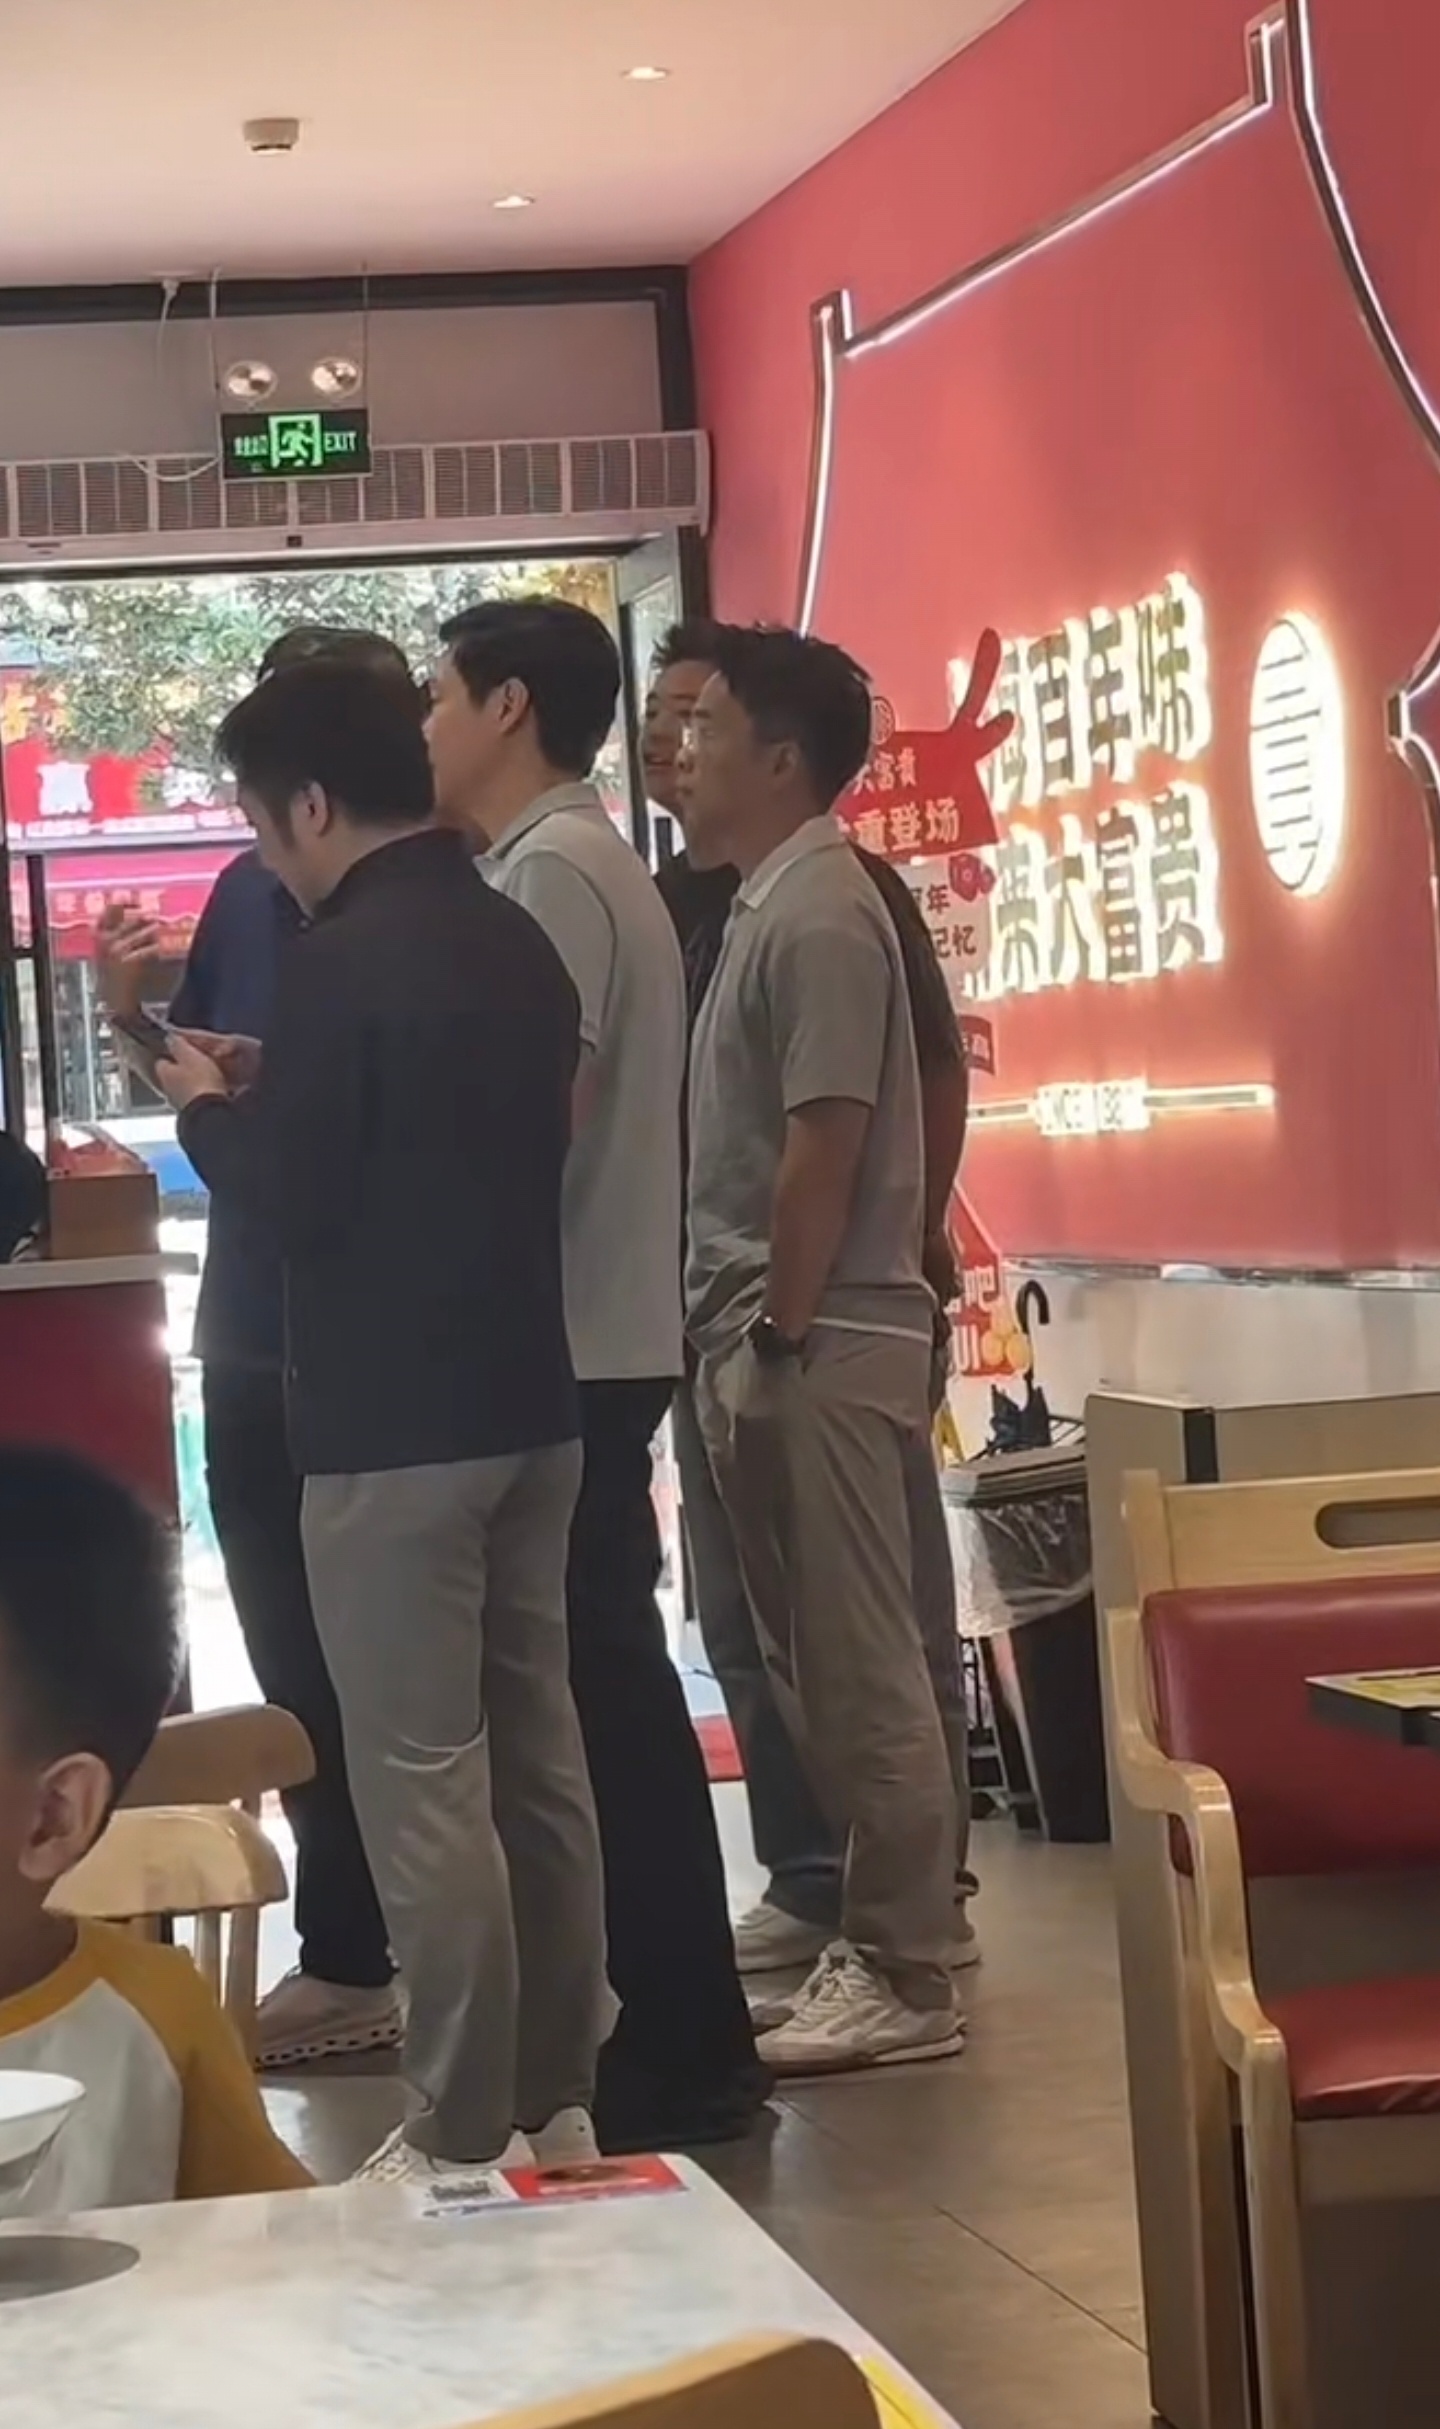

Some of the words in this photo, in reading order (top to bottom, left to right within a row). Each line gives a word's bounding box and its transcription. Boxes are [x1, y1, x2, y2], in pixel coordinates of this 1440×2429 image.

[323, 430, 357, 452] EXIT
[837, 797, 961, 854] 重登场
